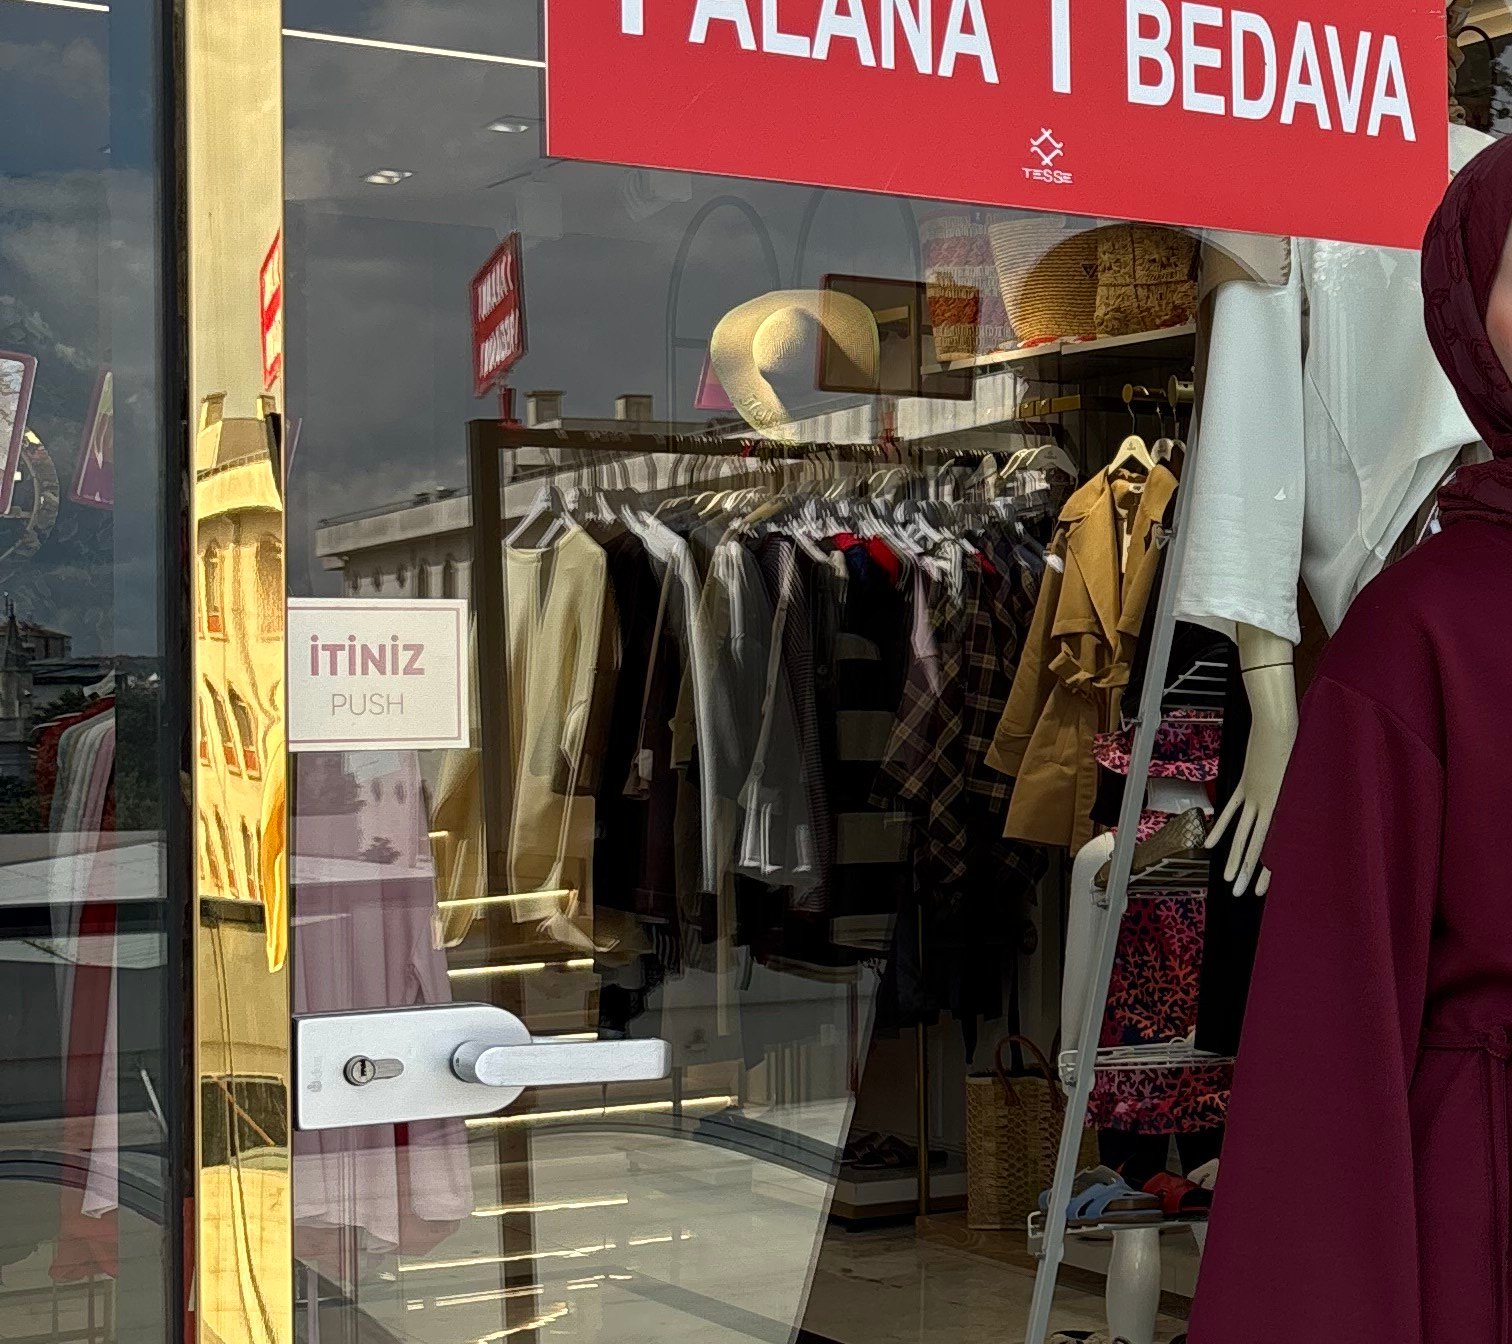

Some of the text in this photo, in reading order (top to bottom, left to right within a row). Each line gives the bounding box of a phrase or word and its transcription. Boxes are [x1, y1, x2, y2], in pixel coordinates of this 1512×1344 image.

[1021, 167, 1074, 184] TESSE
[310, 634, 426, 677] İTİNİZ
[331, 693, 404, 716] PUSH
